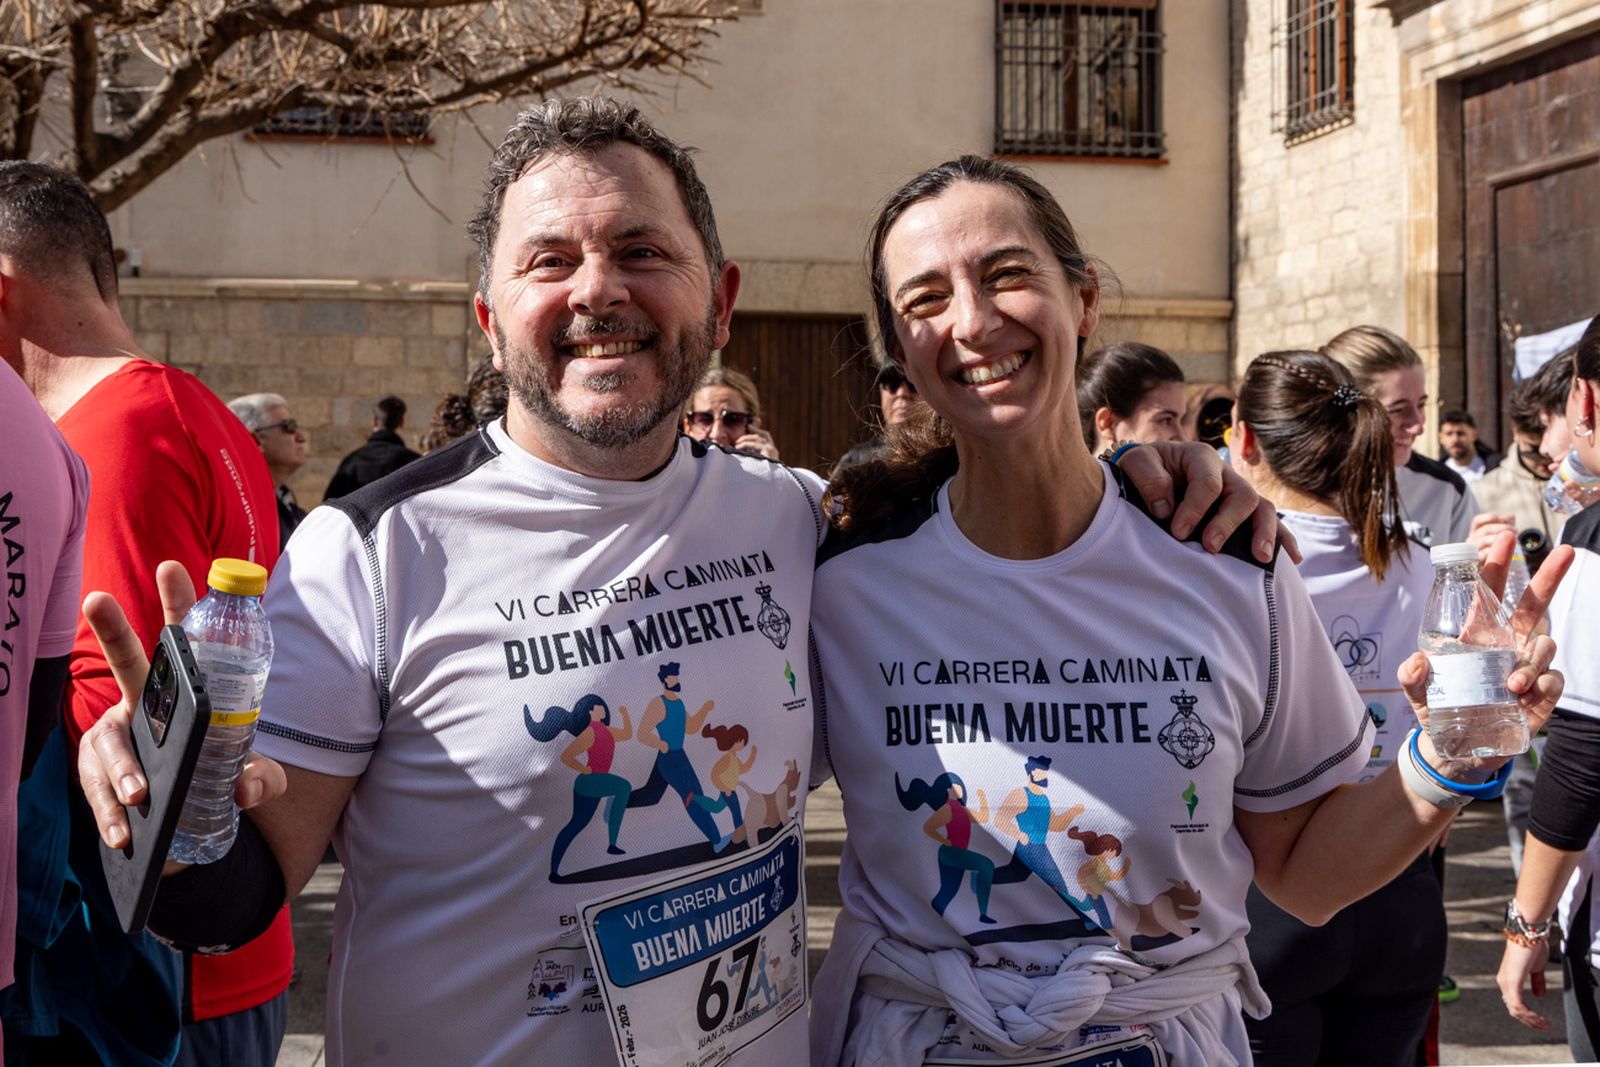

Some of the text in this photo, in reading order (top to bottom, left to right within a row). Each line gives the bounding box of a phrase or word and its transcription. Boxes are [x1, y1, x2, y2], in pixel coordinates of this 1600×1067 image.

[495, 549, 775, 622] VI CARRERA CAMINATA
[503, 594, 756, 681] BUENA MUERTE
[879, 655, 1213, 686] VI CARRERA CAMINATA
[886, 701, 1152, 747] BUENA MUERTE
[624, 850, 785, 931] VI CARRERA CAMINATA
[631, 893, 767, 972] BUENA MUERTE
[616, 1004, 631, 1029] 2026
[695, 934, 762, 1032] 67
[697, 1030, 719, 1051] JUAN
